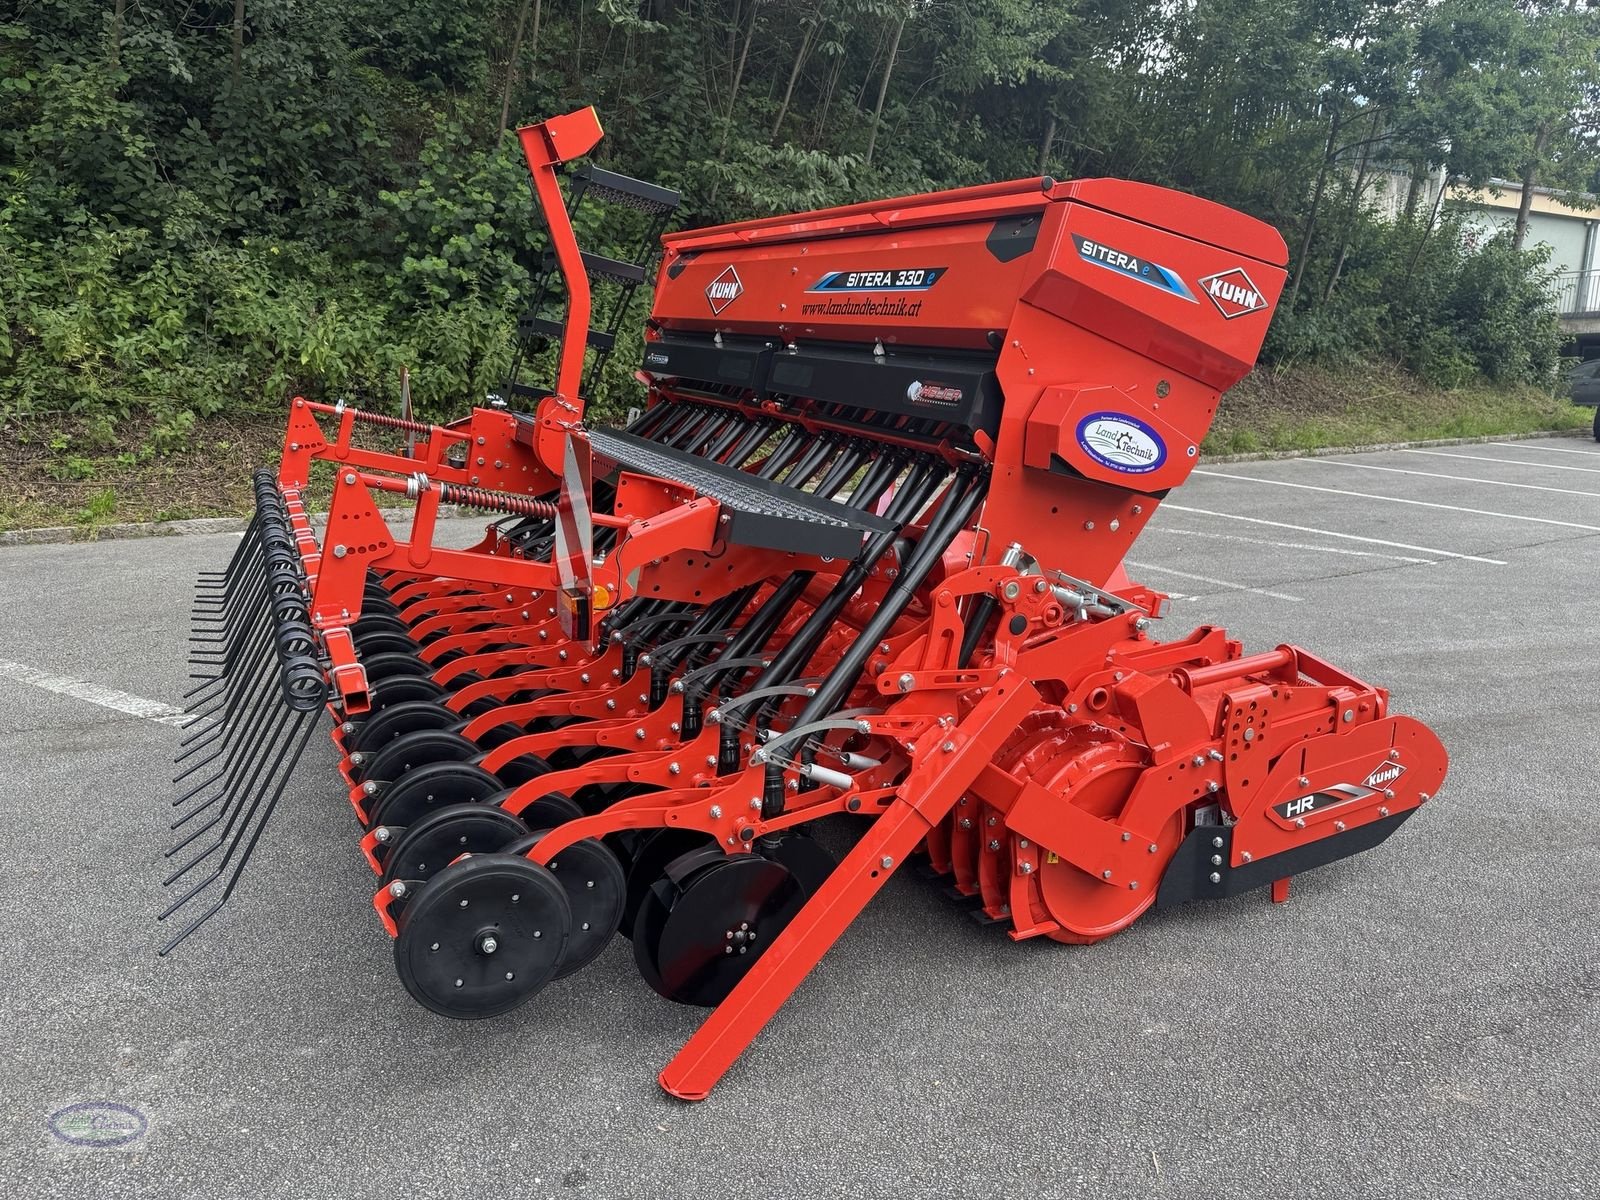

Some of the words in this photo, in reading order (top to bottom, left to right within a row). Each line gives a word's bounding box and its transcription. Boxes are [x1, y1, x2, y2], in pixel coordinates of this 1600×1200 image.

[1081, 240, 1139, 273] SITERA
[846, 271, 891, 287] SITERA
[895, 270, 925, 286] 330
[927, 272, 936, 284] e
[710, 283, 739, 299] KUHN
[1209, 278, 1257, 309] KUHN
[801, 297, 923, 317] www.landundtechnik.at
[1095, 424, 1118, 441] Land
[1122, 441, 1153, 461] Technik
[1368, 767, 1400, 786] KUHN
[1286, 795, 1315, 818] HR
